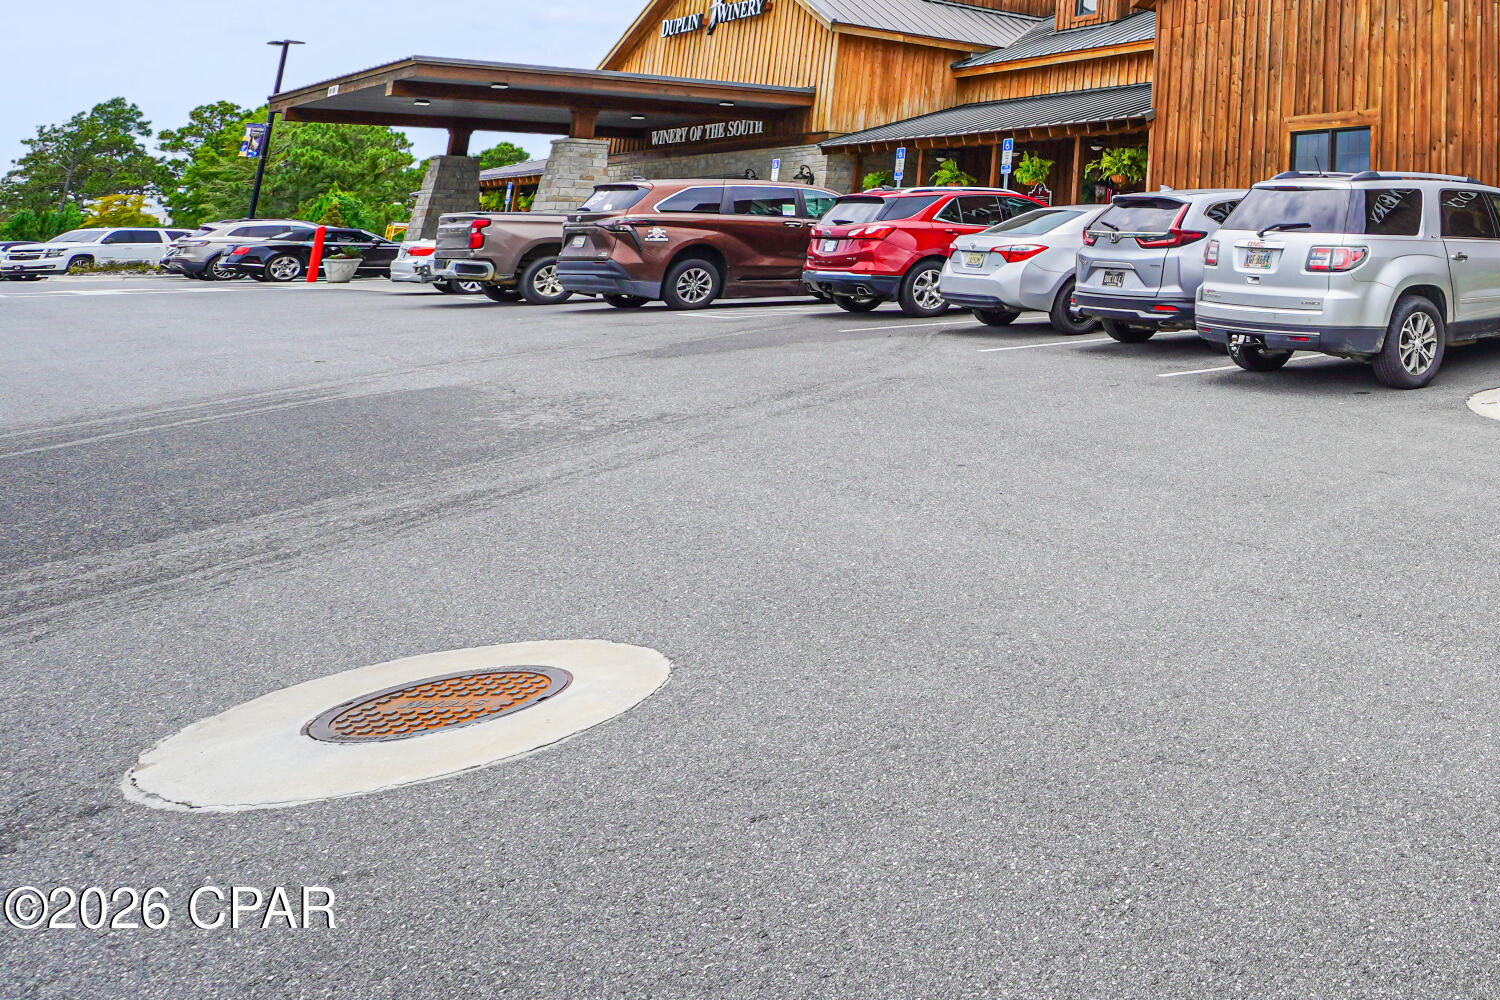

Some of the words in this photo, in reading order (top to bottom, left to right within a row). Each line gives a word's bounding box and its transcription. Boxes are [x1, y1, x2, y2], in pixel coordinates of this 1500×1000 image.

[661, 12, 704, 37] DUPLIN
[651, 127, 688, 146] WINERY
[689, 125, 704, 142] OF
[705, 122, 726, 140] THE
[727, 120, 764, 137] SOUTH
